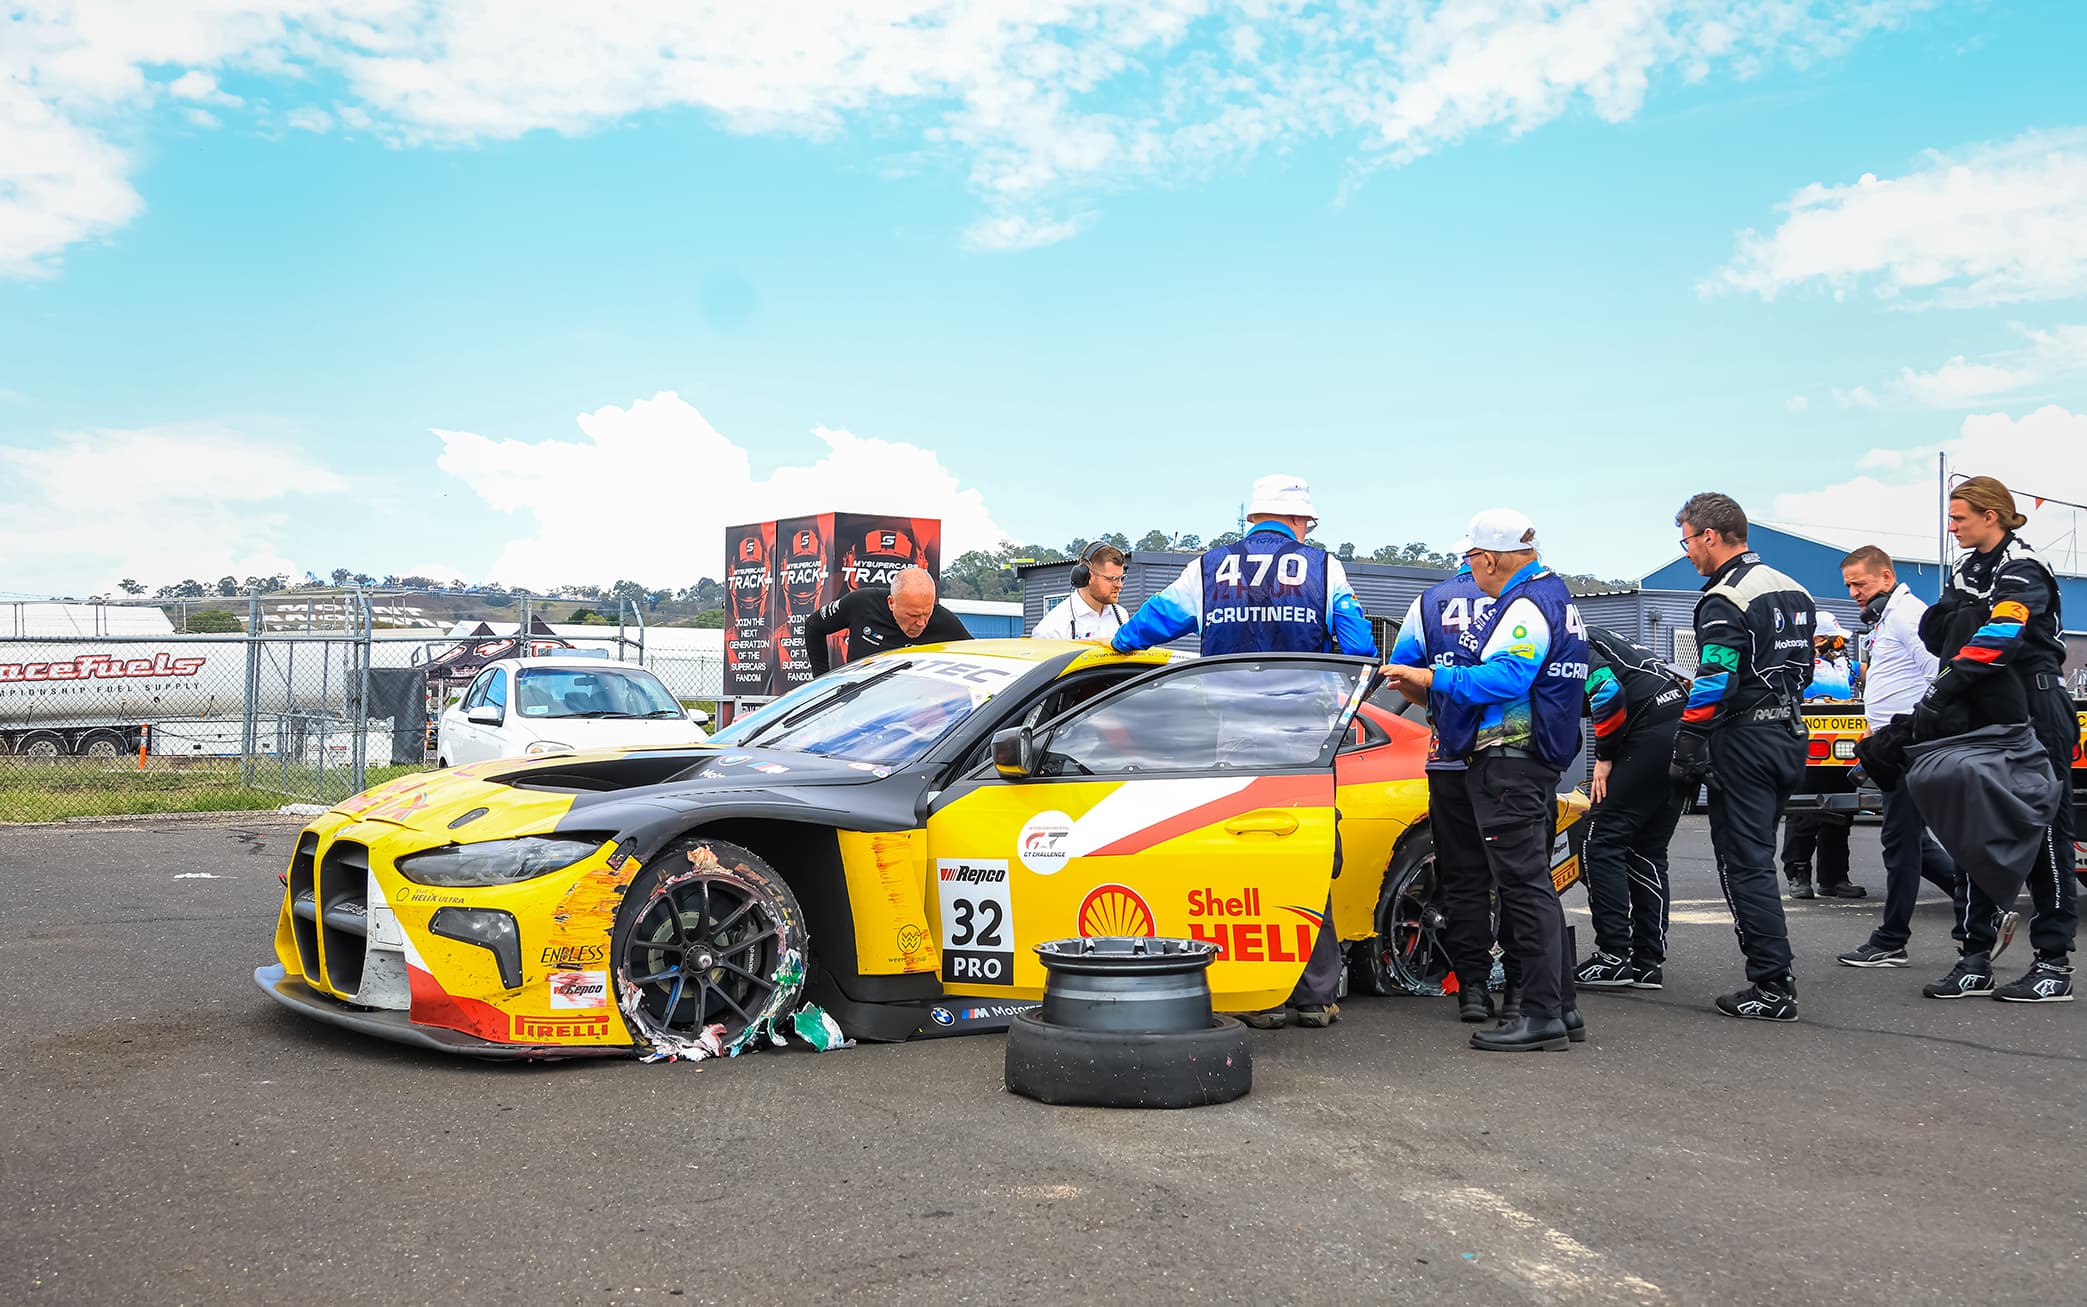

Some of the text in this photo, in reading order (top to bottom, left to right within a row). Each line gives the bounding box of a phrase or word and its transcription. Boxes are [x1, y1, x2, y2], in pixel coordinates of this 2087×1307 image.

[842, 567, 898, 584] TRAC
[1215, 553, 1308, 587] 470
[787, 615, 805, 624] JOIN
[1205, 605, 1318, 626] SCRUTINEER
[735, 617, 765, 627] JOIN THE
[740, 629, 758, 638] NEXT
[729, 640, 770, 649] GENERATION
[780, 638, 806, 647] GENERA
[738, 651, 760, 660] OF THE
[790, 649, 799, 658] OF
[1706, 646, 1738, 670] 32
[731, 662, 767, 671] SUPERCARS
[782, 661, 811, 670] SUPERCA
[735, 673, 761, 682] FANDOM
[97, 685, 133, 693] FUEL
[145, 682, 200, 692] SUPPLY
[1752, 706, 1791, 721] RACING
[1805, 718, 1867, 729] NOT OVERT
[955, 865, 1006, 885] Repco
[411, 893, 466, 905] HELIX ULTRA
[1187, 887, 1261, 917] Shell
[951, 898, 1003, 947] 32
[1187, 923, 1312, 963] HELI
[540, 944, 605, 964] ENDLESS
[953, 956, 1002, 979] PRO
[515, 1014, 610, 1038] PIRELLI
